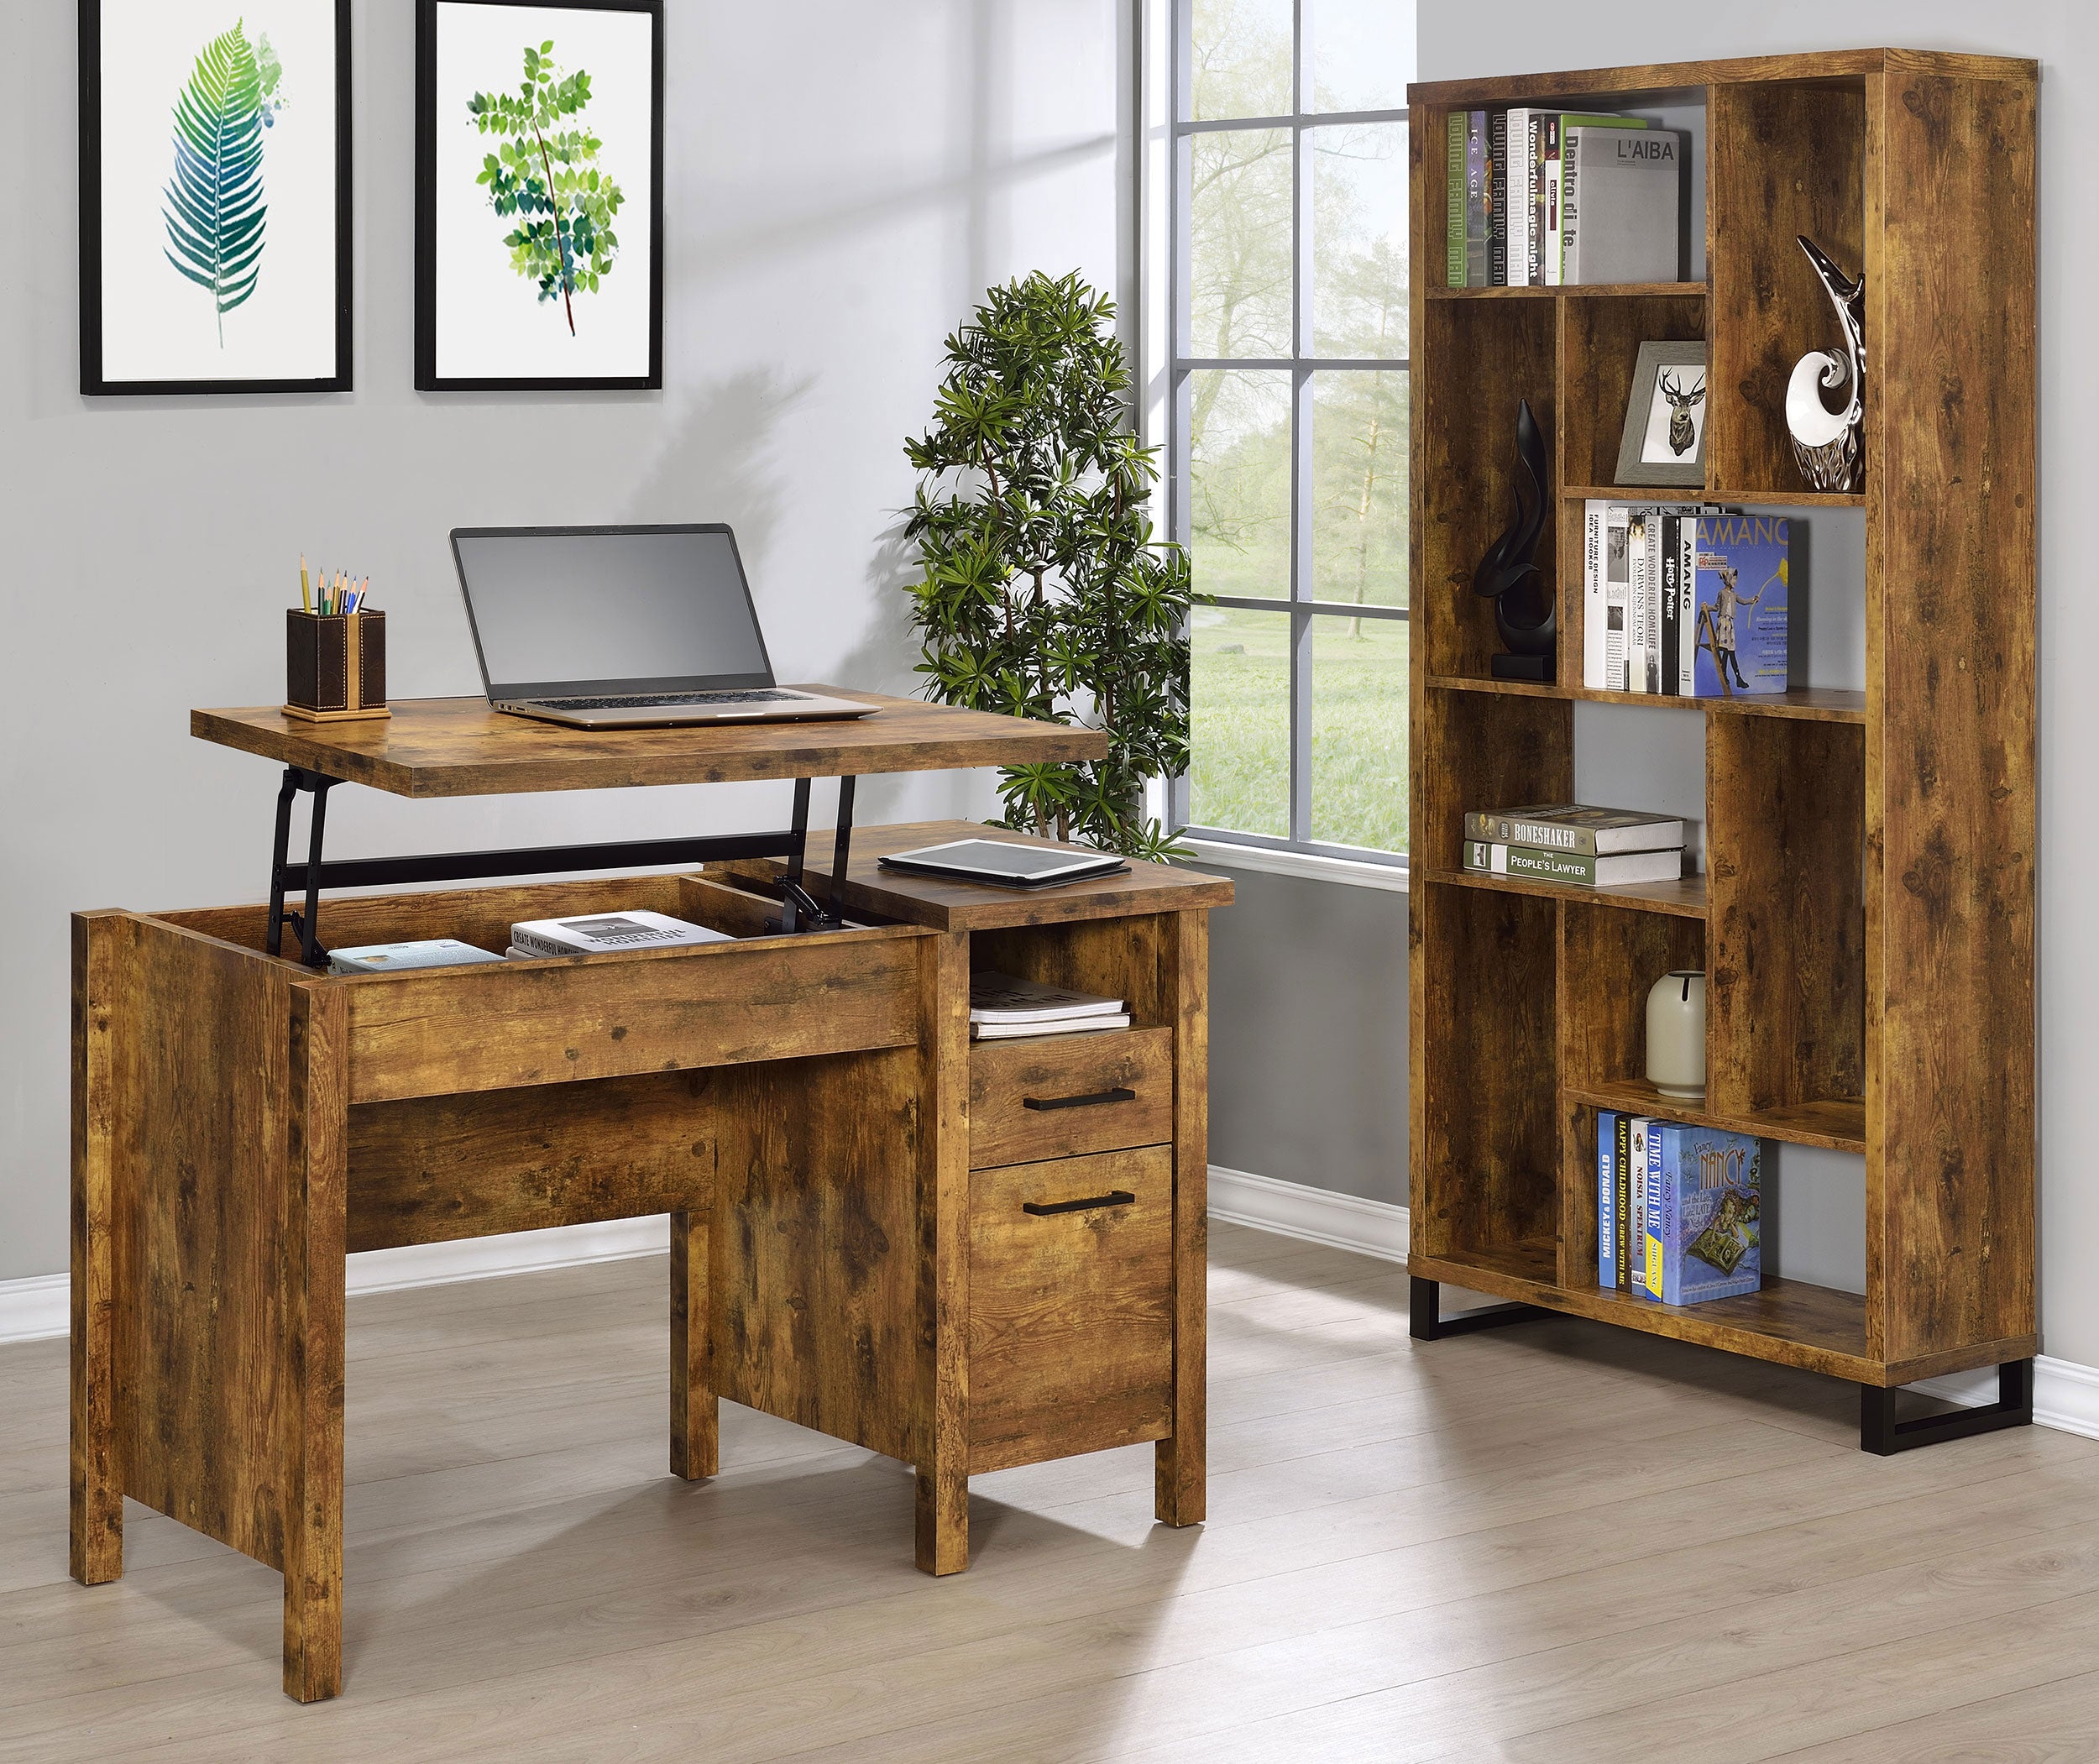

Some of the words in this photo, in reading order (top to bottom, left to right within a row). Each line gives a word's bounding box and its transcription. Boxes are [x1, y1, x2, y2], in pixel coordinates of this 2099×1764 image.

[1564, 136, 1578, 196] Dentro
[1617, 139, 1674, 160] L'AIBA
[1470, 169, 1479, 198] AGE
[1449, 178, 1463, 239] FAMILY
[1493, 178, 1505, 239] FAMILY
[1509, 175, 1523, 237] FAMILY
[1563, 203, 1578, 220] di
[1563, 229, 1577, 247] te
[1448, 247, 1463, 284] MAN
[1493, 247, 1505, 284] MAN
[1509, 244, 1523, 281] MAN
[1528, 241, 1538, 277] night
[1647, 523, 1656, 552] CREATE
[1636, 558, 1645, 610] DARWINS
[1647, 555, 1656, 605] WONDERFUL
[1665, 556, 1675, 587] Harry
[1683, 541, 1692, 610] AMANG
[1664, 587, 1676, 620] Potter
[1647, 609, 1656, 649] HOMELIFE
[1514, 823, 1576, 849] BONESHAKER
[1510, 855, 1550, 871] PEOPLE'S
[1552, 861, 1586, 876] LAWYER
[513, 930, 530, 947] CREATE
[530, 934, 557, 955] WONDERFUL
[583, 928, 687, 943] WONDERFUL
[603, 933, 687, 946] HOMELIFE
[1648, 1133, 1661, 1167] TIME
[1601, 1154, 1610, 1205] DONALD
[1700, 1148, 1746, 1190] NANCY
[1648, 1170, 1661, 1207] WITH
[1663, 1172, 1672, 1202] Fancy
[1648, 1207, 1661, 1229] ME
[1663, 1204, 1673, 1238] Nancy
[1602, 1212, 1611, 1259] MICKEY
[1619, 1272, 1625, 1285] ME
